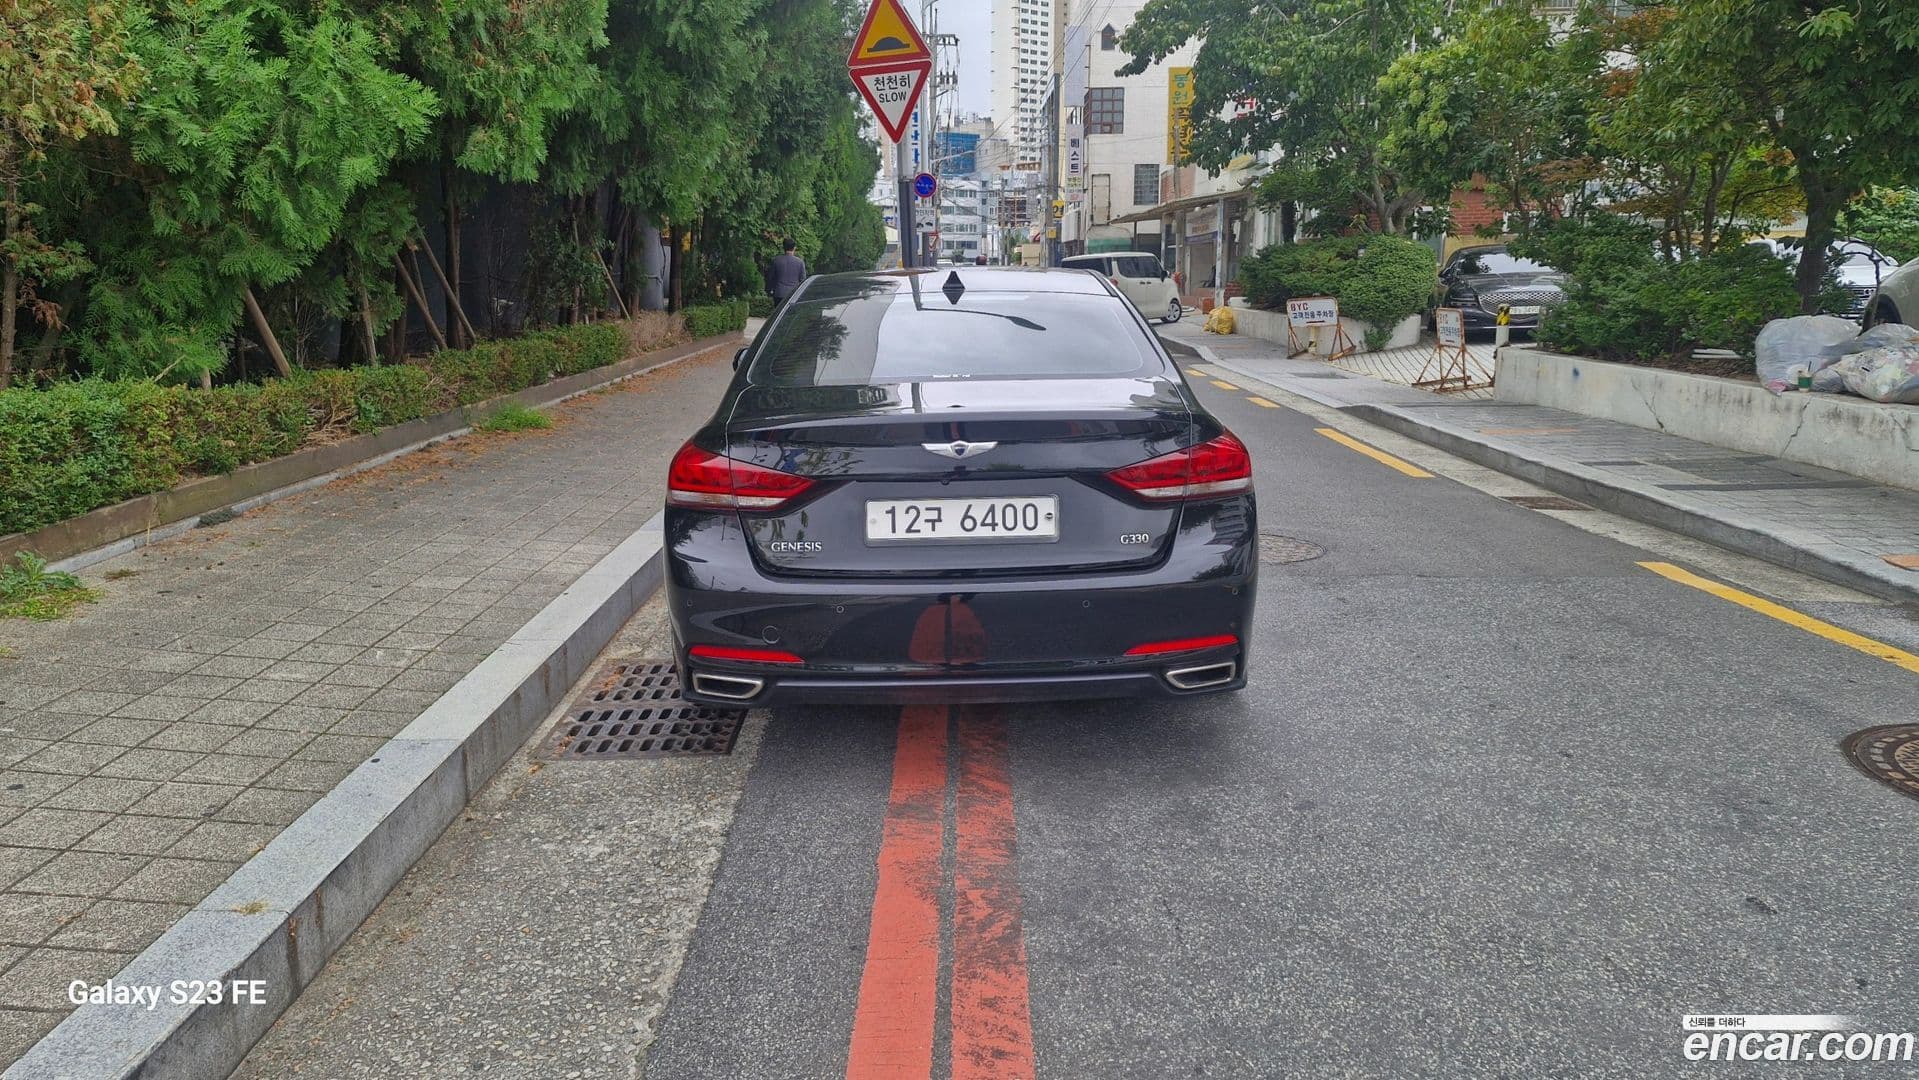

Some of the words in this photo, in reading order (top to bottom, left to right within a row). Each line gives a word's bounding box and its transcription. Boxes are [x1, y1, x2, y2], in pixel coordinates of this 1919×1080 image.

[874, 74, 911, 91] 천천히
[878, 91, 907, 103] SLOW
[1070, 138, 1080, 173] 베스트
[1290, 303, 1309, 311] BYC
[884, 502, 944, 535] 12구
[959, 502, 1039, 532] 6400
[1119, 533, 1149, 545] G330
[770, 540, 822, 552] GENESIS
